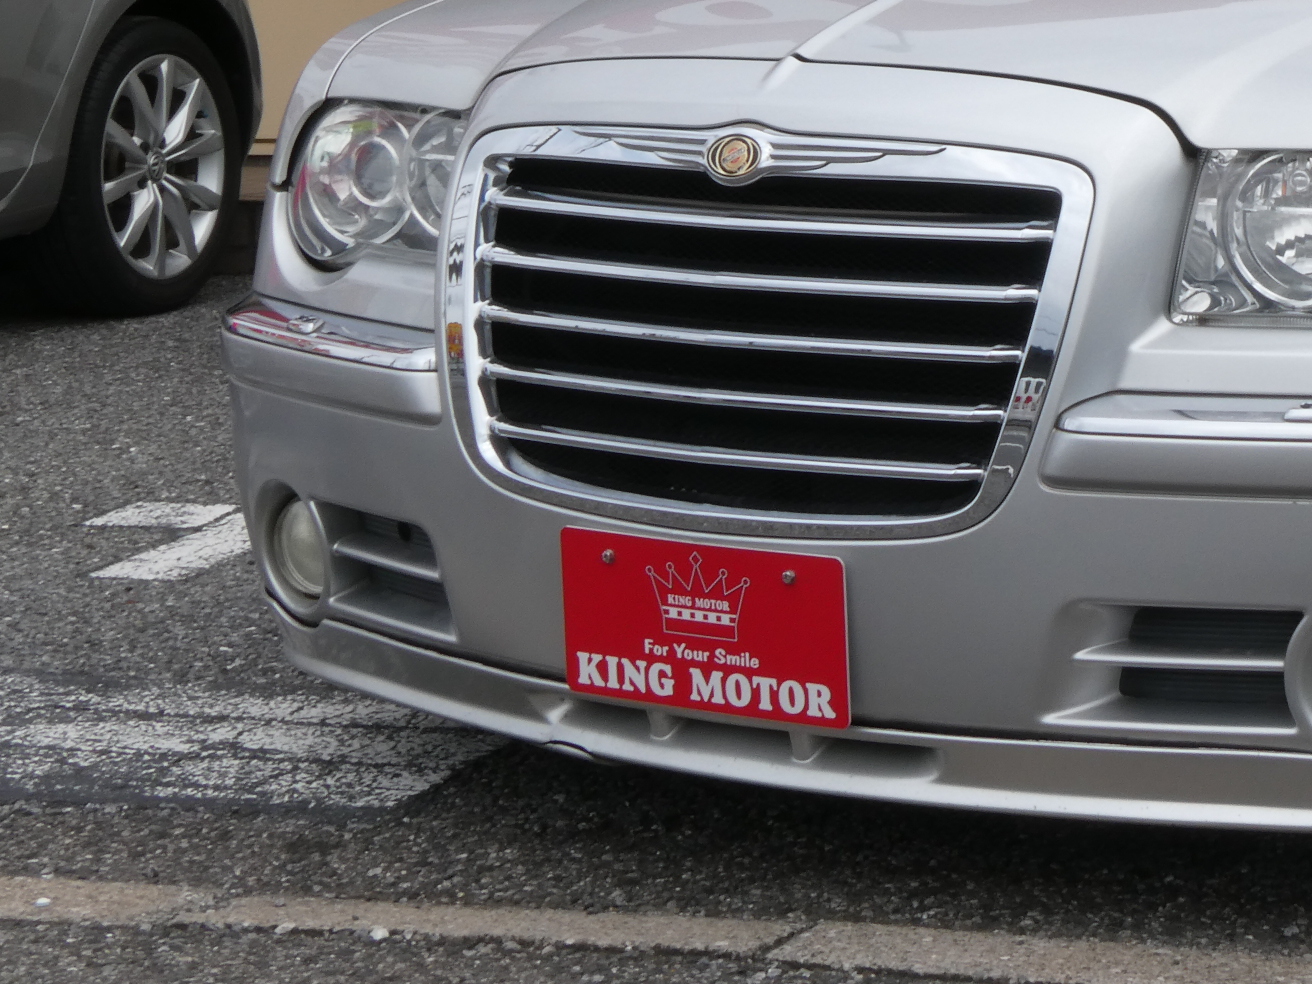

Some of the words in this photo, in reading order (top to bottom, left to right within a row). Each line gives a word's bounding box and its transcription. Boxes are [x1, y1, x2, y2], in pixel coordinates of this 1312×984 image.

[667, 593, 692, 608] KING
[694, 597, 730, 612] MOTOR
[644, 638, 669, 657] For
[673, 642, 709, 662] Your
[714, 648, 760, 669] Smile
[576, 651, 675, 697] KING
[689, 667, 836, 720] MOTOR
